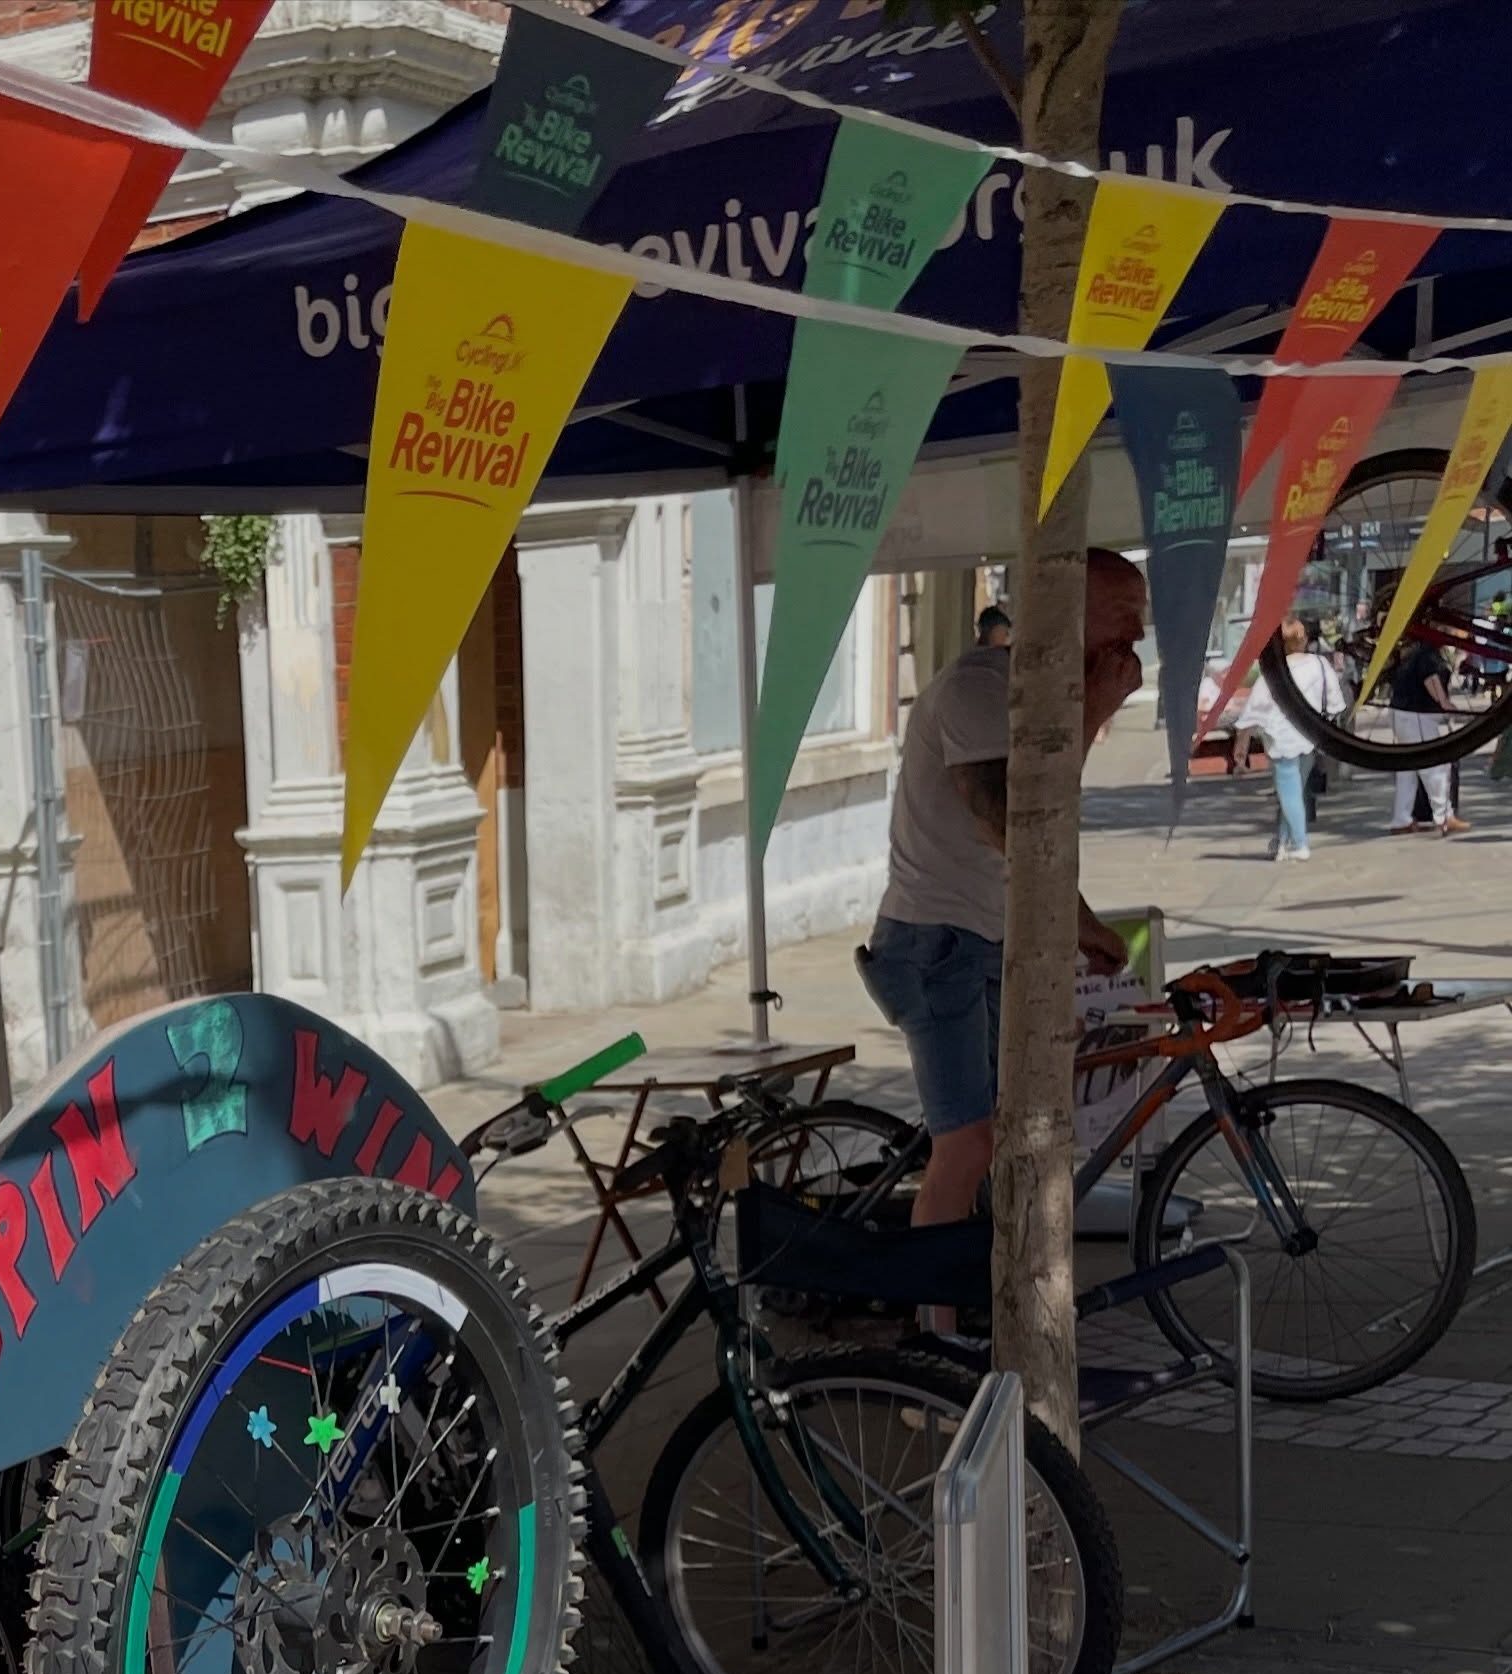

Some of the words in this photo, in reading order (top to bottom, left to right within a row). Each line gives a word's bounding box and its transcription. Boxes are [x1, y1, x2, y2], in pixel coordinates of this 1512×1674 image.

[495, 123, 602, 187] Revival
[824, 218, 916, 269] Revival
[862, 203, 906, 238] Bike
[1086, 273, 1164, 313] Revival
[1300, 293, 1375, 322] Revival
[444, 379, 515, 437] Bike
[389, 411, 530, 488] Revival
[837, 445, 882, 489] Bike
[797, 477, 889, 531] Revival
[165, 999, 249, 1152] 2
[288, 1029, 464, 1201] WIN
